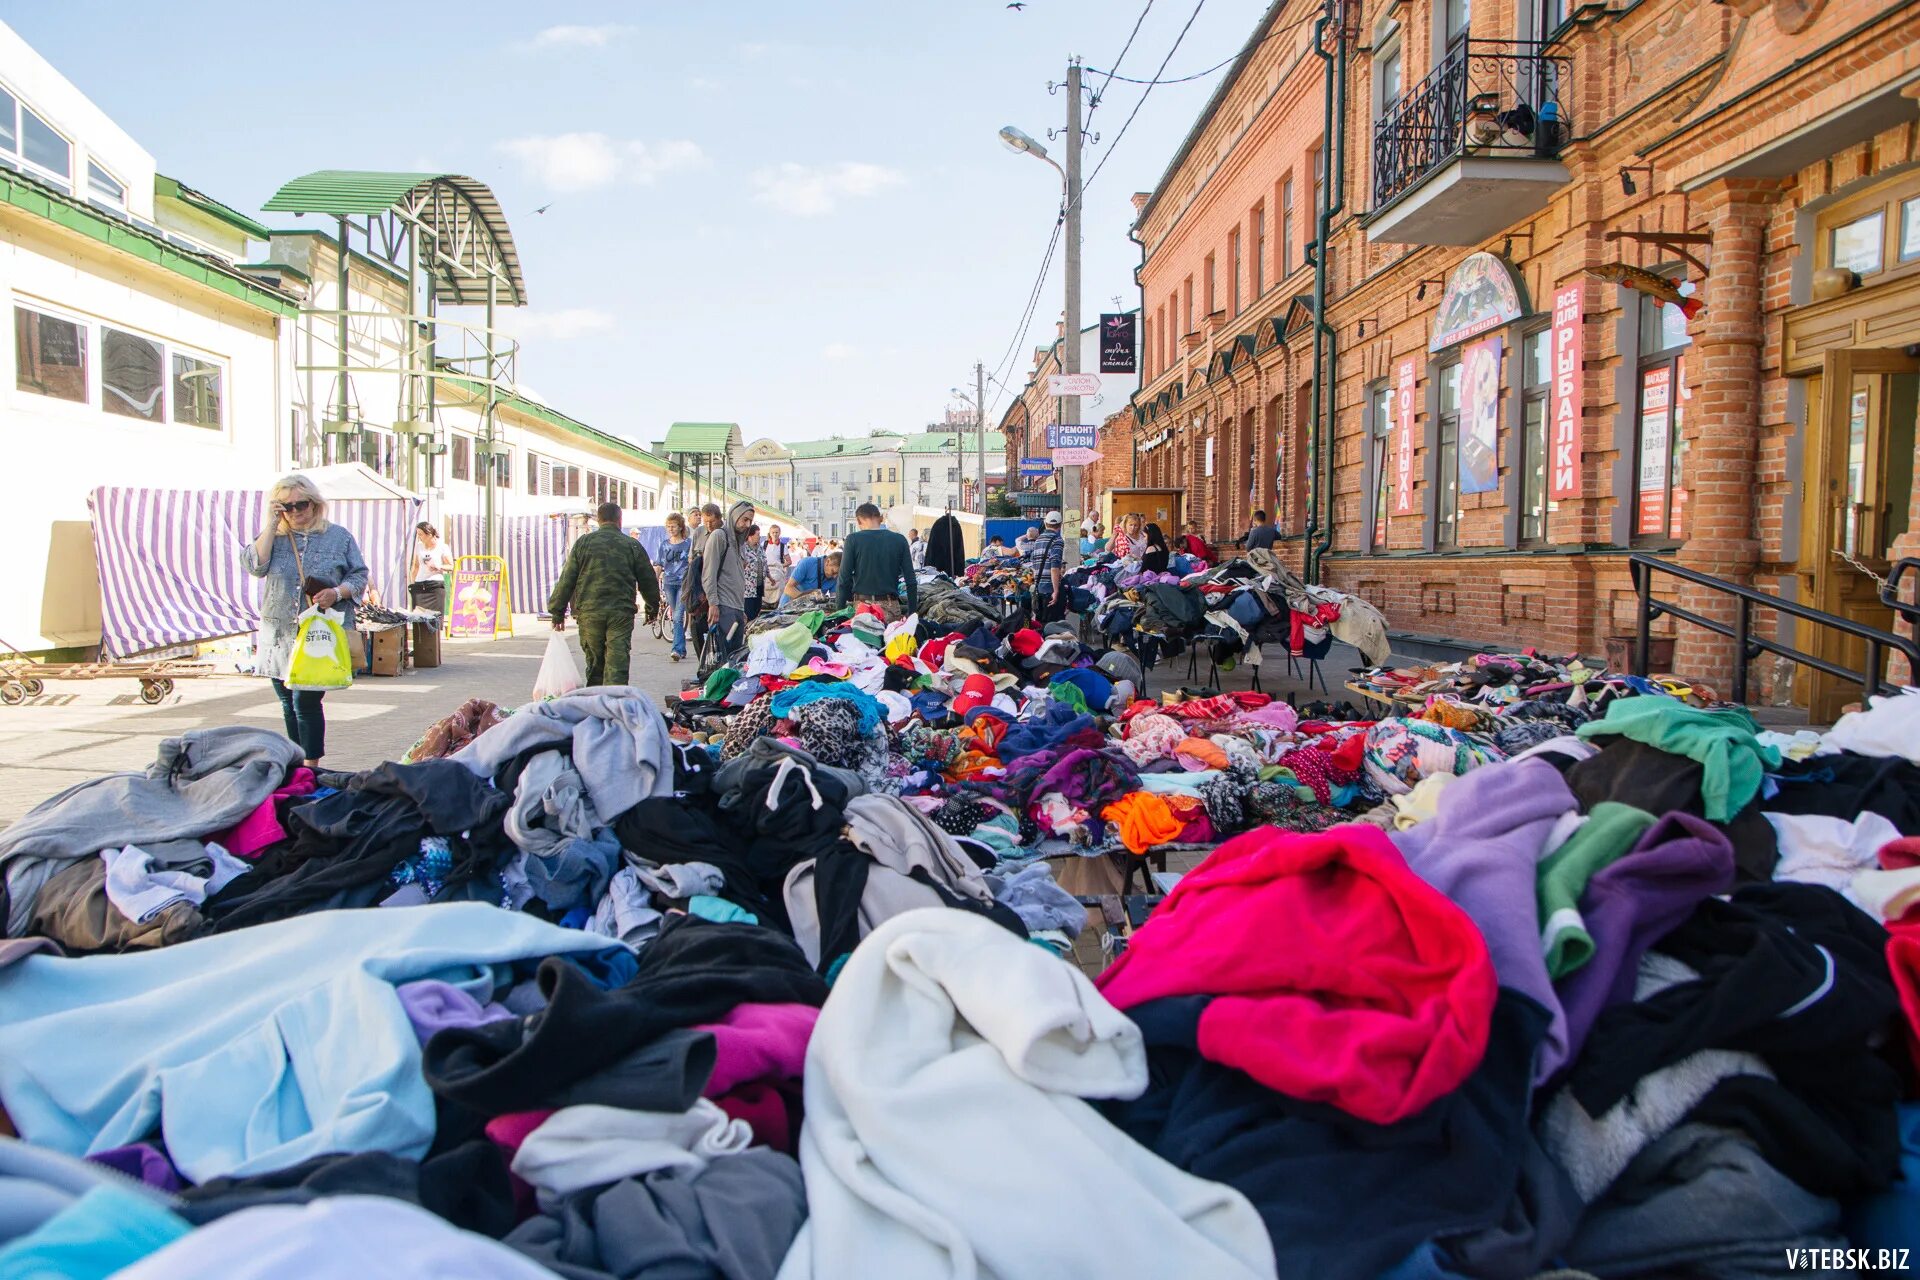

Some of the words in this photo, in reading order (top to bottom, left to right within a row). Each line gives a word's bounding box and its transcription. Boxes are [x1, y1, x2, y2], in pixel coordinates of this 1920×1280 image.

[1557, 289, 1577, 309] ВСЕ
[1556, 304, 1578, 328] ДЛЯ
[1445, 333, 1456, 344] ВСЕ
[1458, 328, 1470, 339] ДЛЯ
[1471, 316, 1499, 333] РЫБАЛКИ
[1400, 362, 1412, 376] ВСЕ
[1400, 374, 1413, 389] ДЛЯ
[1556, 327, 1575, 491] РЫБАЛКИ
[1059, 426, 1094, 434] РЕМОНТ
[1060, 436, 1093, 446] ОБУВИ
[1398, 390, 1411, 510] ОТДЫХА
